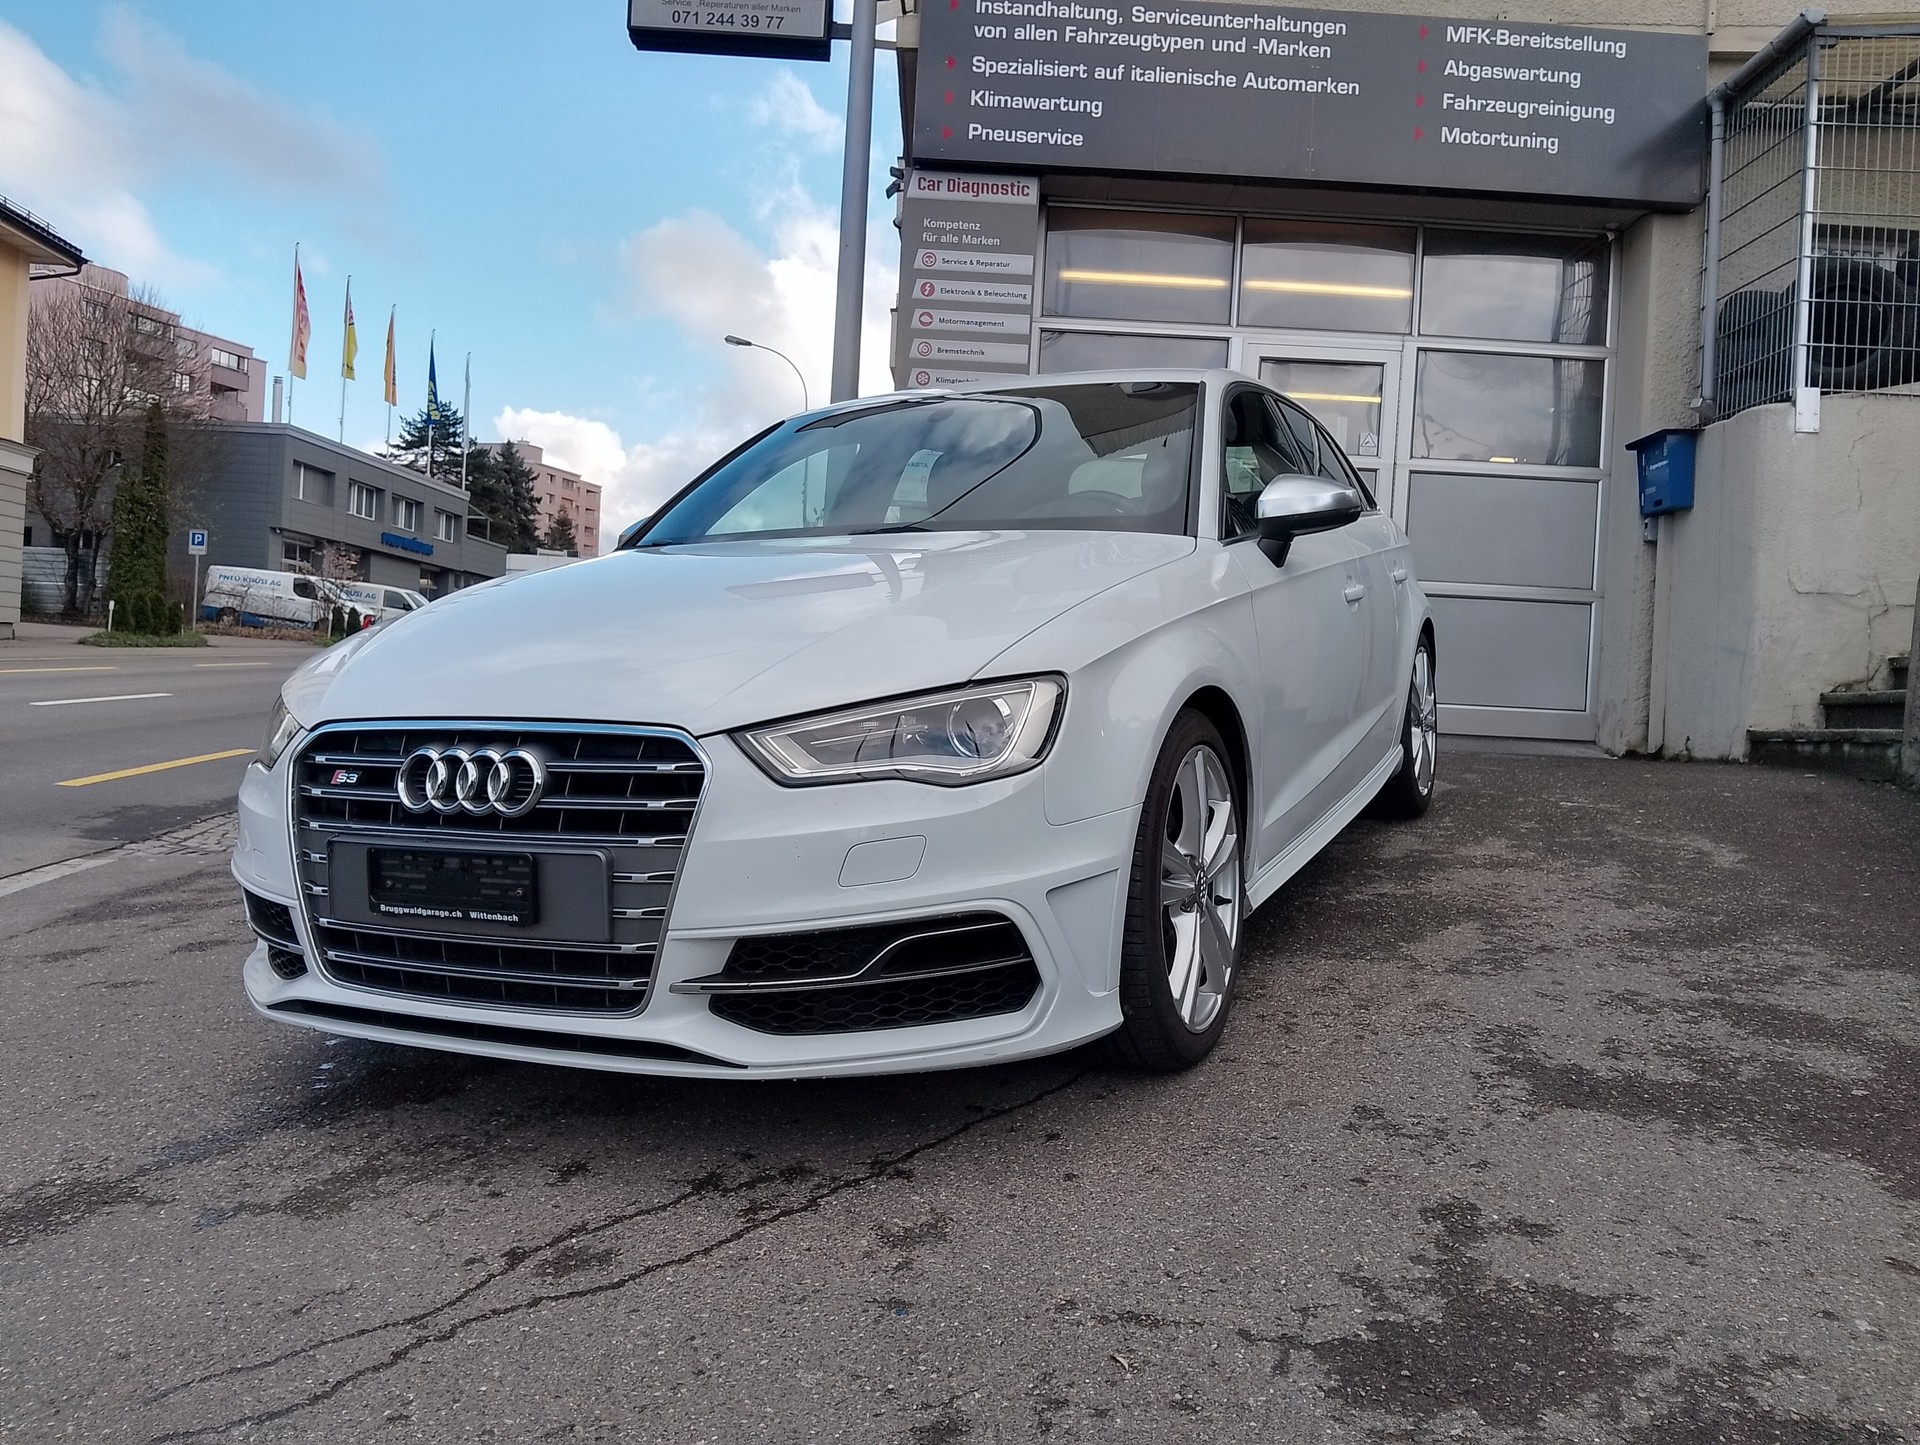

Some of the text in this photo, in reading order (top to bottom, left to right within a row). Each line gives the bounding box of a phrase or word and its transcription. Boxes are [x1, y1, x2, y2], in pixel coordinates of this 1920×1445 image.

[751, 3, 769, 11] aller
[771, 3, 801, 13] Marken
[672, 10, 785, 30] 071 244 39 77
[975, 0, 1347, 38] Instandhaltung, Serviceunterhaltungen
[974, 23, 1332, 59] von allen Fahrzeugtypen und -Marken
[1446, 25, 1627, 59] MFK-Bereitstellung
[971, 56, 1360, 96] Spezialisiert auf italienische Automarken
[1443, 59, 1582, 89] Abgaswartung
[970, 89, 1103, 117] Klimawartung
[1442, 92, 1616, 125] Fahrzeugreinigung
[968, 123, 1084, 147] Pneuservice
[1440, 126, 1559, 155] Motortuning
[917, 176, 1031, 198] Car Diagnostic
[923, 218, 981, 231] Kompetenz
[922, 232, 1000, 246] für alle Marken
[941, 257, 968, 266] Service
[976, 259, 1010, 268] Reparatur
[940, 287, 1028, 300] Elektronik & Beleuchtung
[938, 317, 1005, 328] Motormanagement
[937, 347, 985, 356] Bremstechnik
[195, 534, 203, 545] P
[336, 773, 359, 783] S3
[380, 904, 519, 922] Bruggwaldgarage.ch Wittenbach
